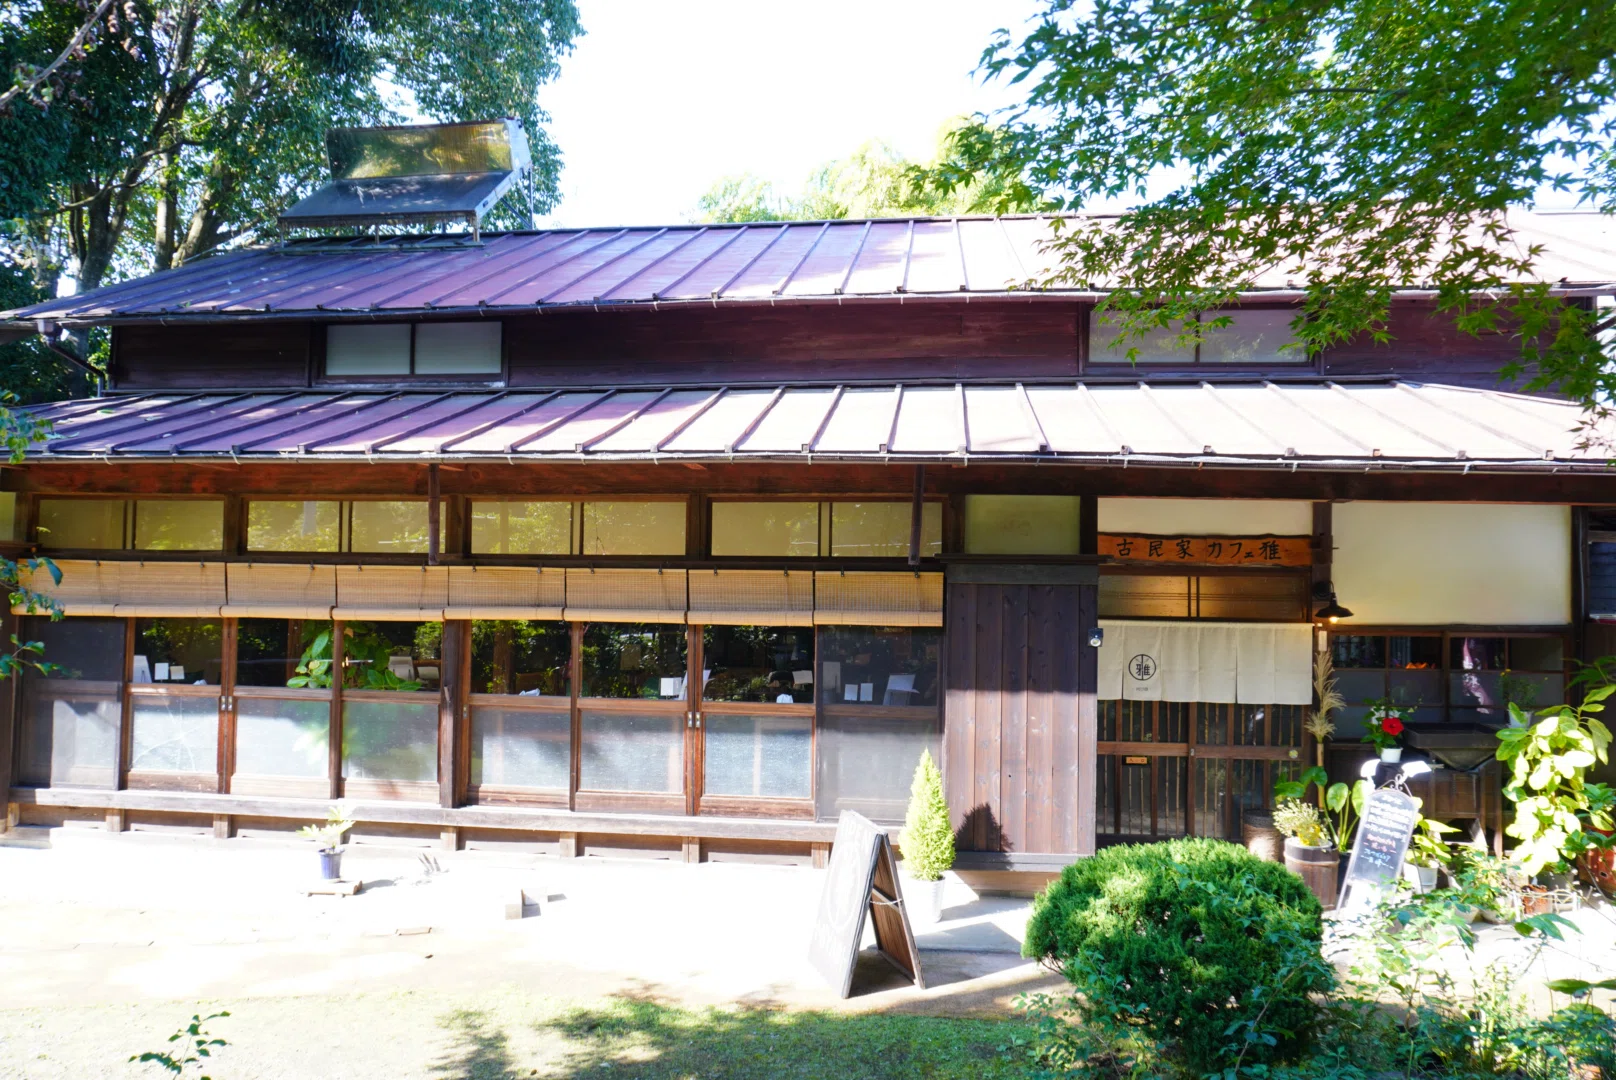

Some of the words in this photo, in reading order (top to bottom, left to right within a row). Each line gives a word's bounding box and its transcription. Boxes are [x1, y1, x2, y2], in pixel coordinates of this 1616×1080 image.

[1116, 538, 1282, 560] 古民家カフェ雅
